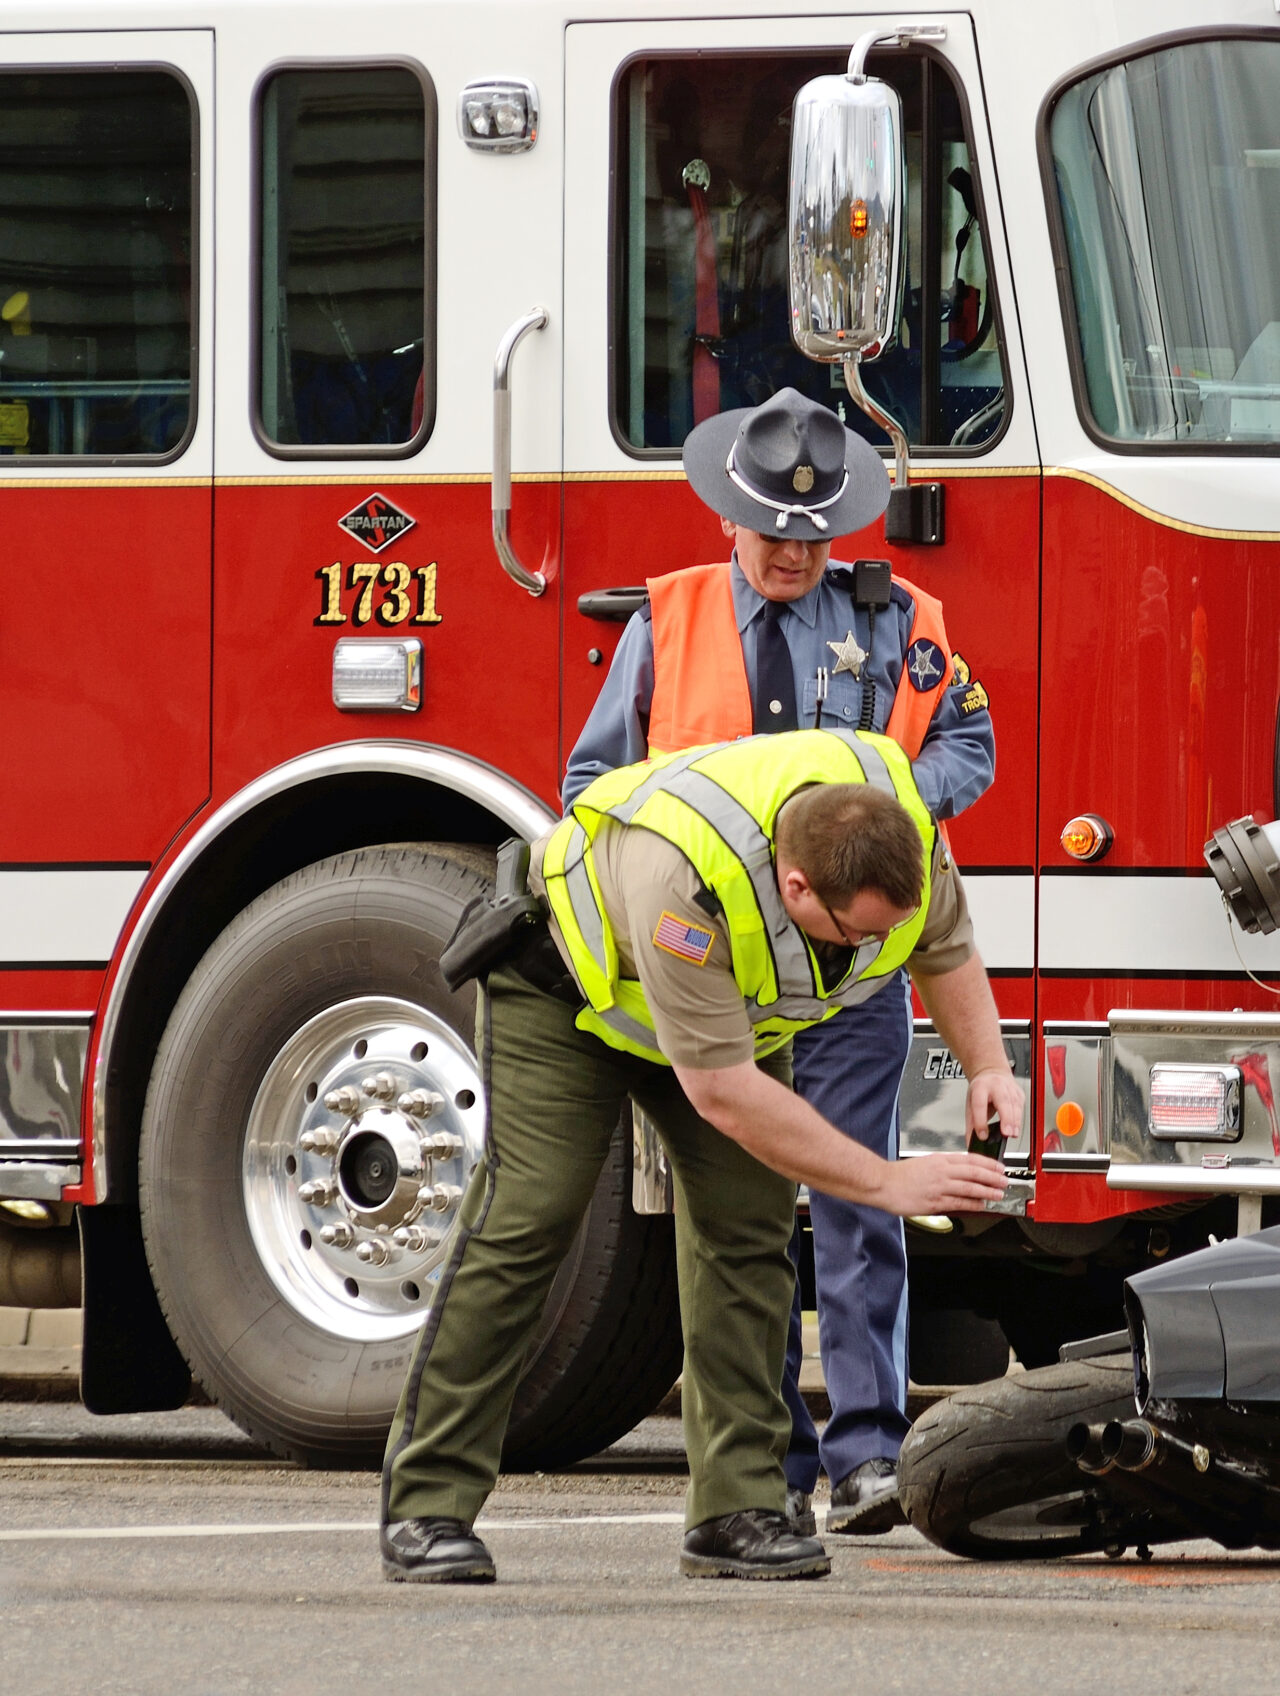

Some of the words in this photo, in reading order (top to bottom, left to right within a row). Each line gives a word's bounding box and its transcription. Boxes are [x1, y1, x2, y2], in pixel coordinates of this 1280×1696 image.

[346, 516, 406, 530] SPARTAN
[314, 561, 443, 627] 1731
[962, 697, 981, 713] TRO
